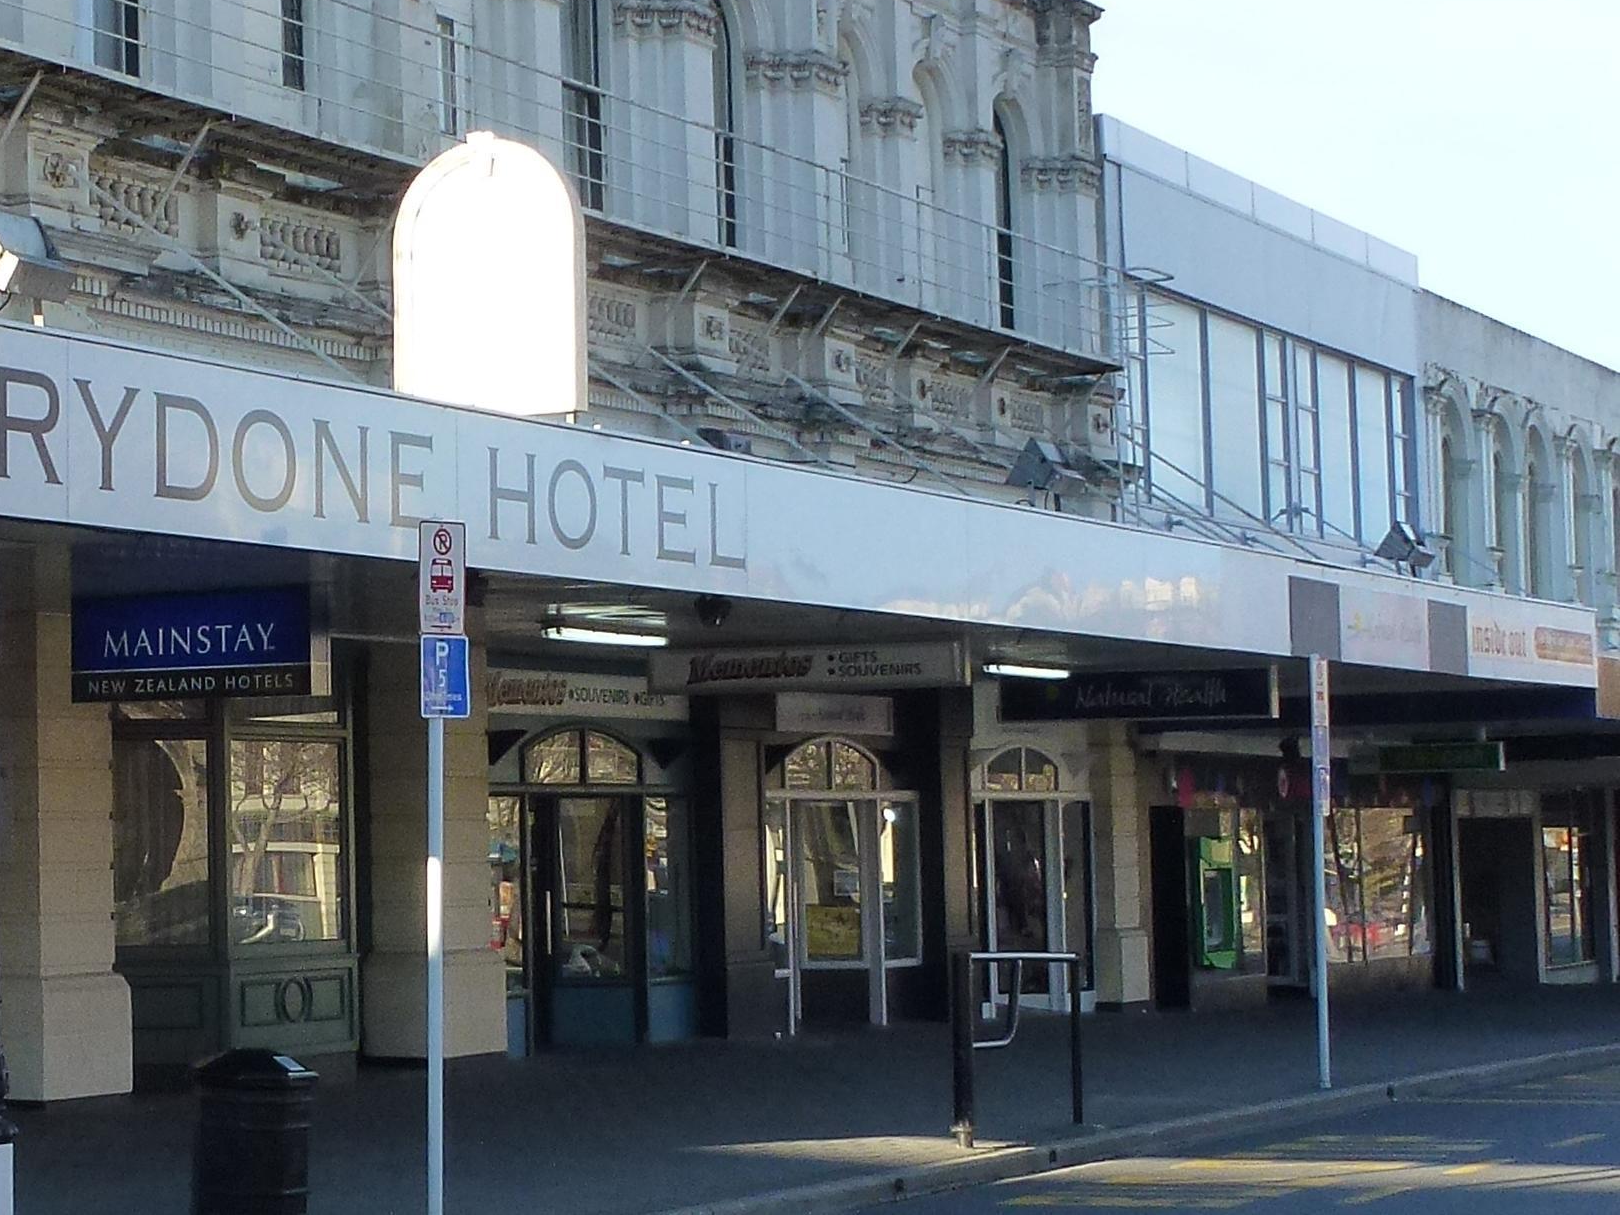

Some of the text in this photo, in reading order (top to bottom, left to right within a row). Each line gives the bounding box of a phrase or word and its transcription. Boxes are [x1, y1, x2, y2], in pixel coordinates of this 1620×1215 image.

[486, 446, 747, 571] HOTEL
[103, 622, 275, 658] MAINSTAY
[435, 641, 449, 666] P
[838, 650, 877, 663] GIFTS
[438, 669, 447, 687] 5
[838, 663, 922, 677] SOUVENIRS
[88, 672, 294, 694] NEW ZEALAND HOTELS
[575, 687, 630, 705] SOUVENIRS
